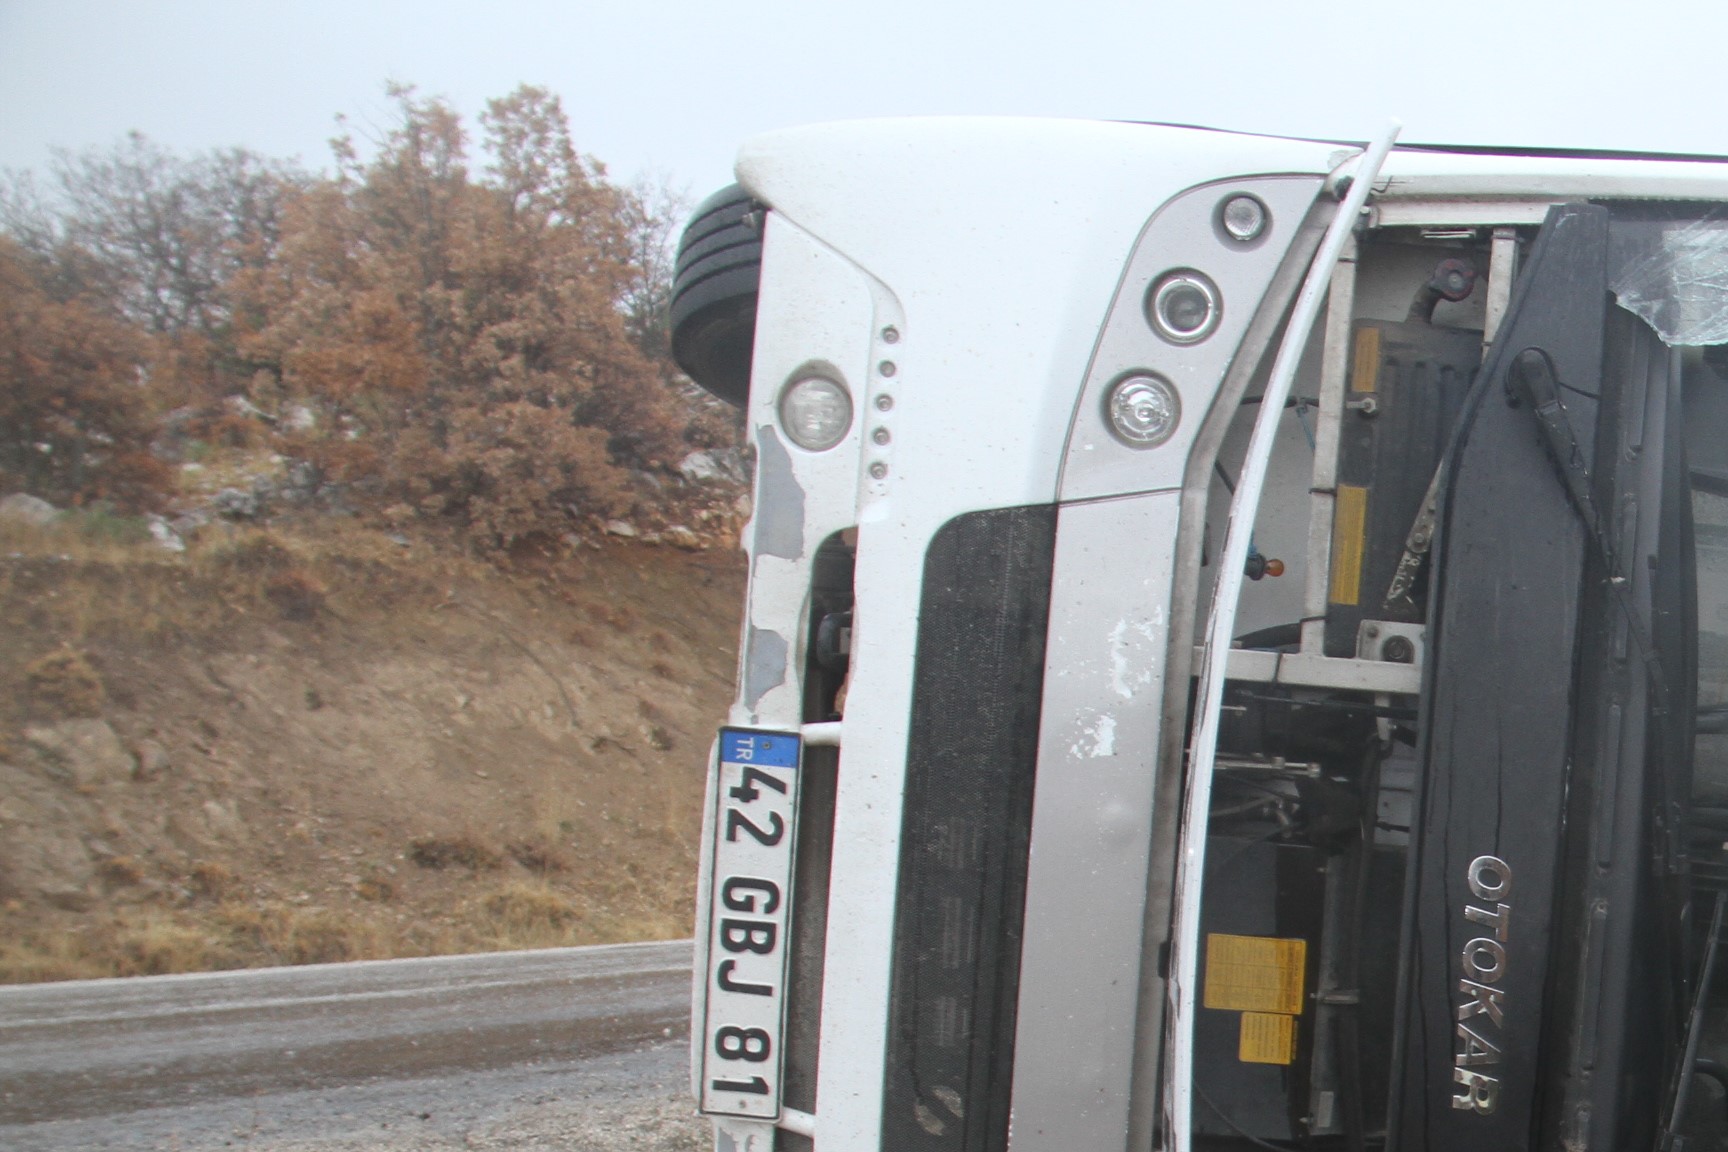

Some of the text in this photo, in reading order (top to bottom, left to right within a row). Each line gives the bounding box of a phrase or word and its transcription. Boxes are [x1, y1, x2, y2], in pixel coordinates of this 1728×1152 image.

[735, 736, 755, 763] TR
[711, 766, 787, 1096] 42 GBJ 81
[1452, 855, 1511, 1115] OTOKAR
